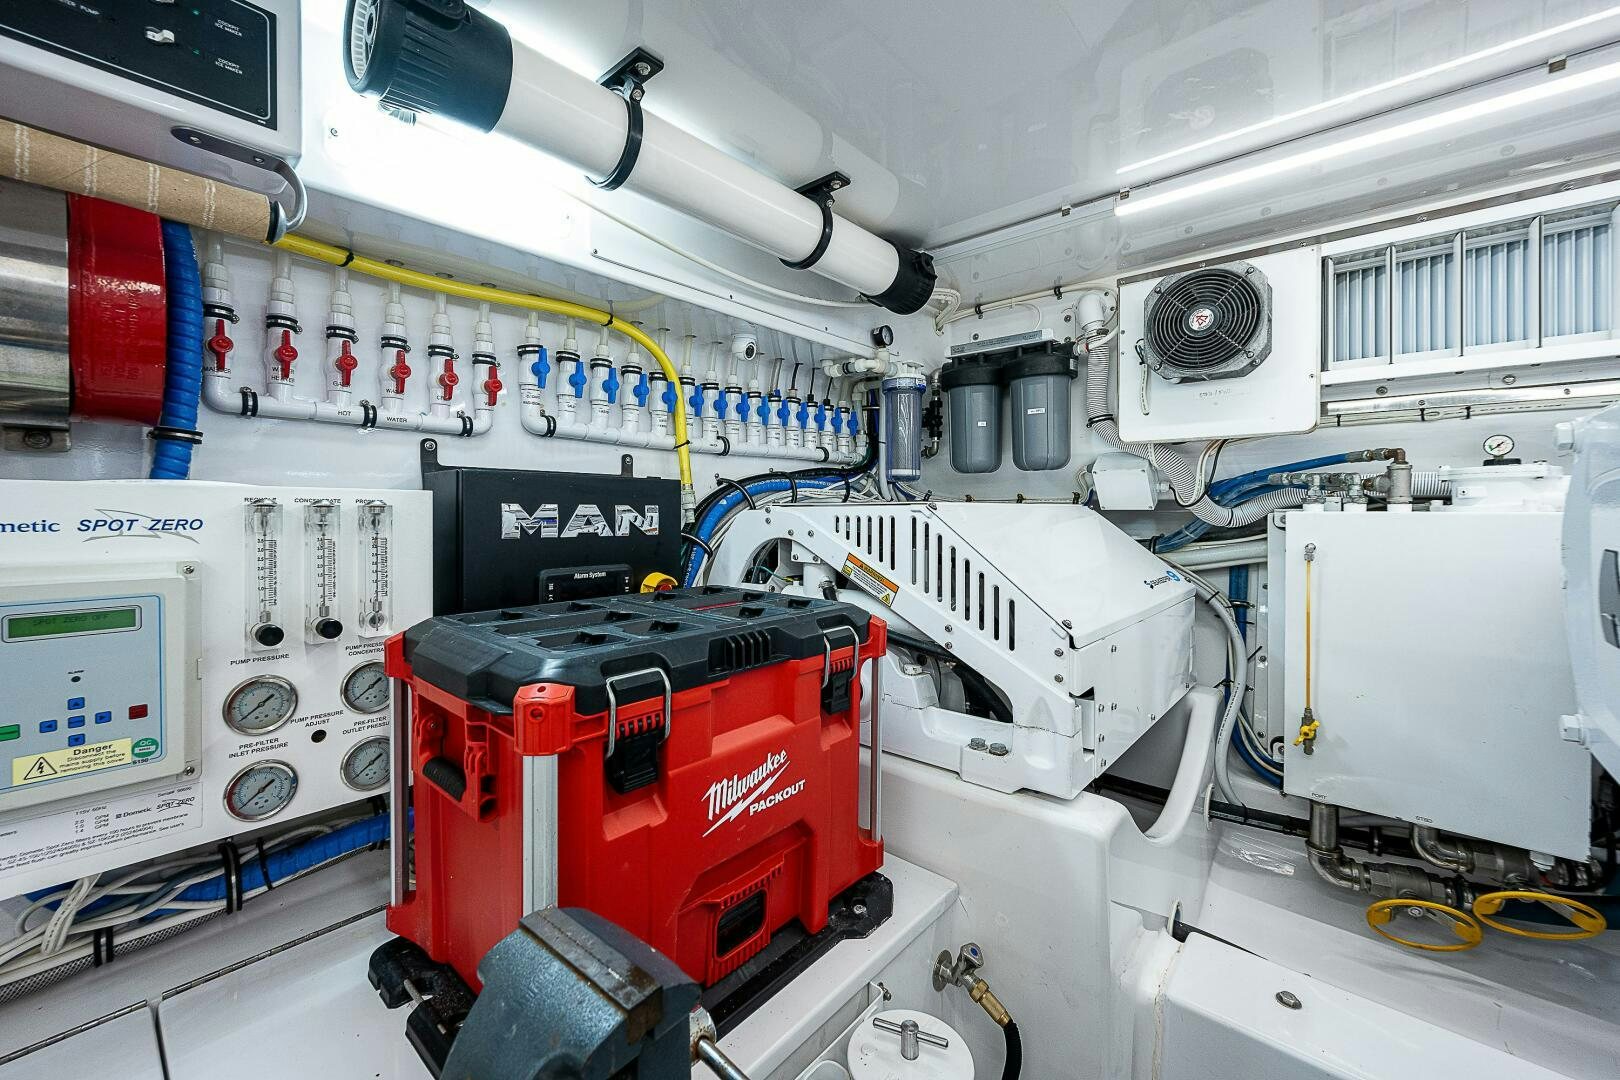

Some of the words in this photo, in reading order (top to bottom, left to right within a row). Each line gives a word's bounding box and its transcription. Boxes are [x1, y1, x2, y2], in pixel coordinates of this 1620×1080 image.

[218, 20, 239, 31] COCKPIT
[225, 26, 242, 36] MAKER
[218, 58, 240, 69] COCKPIT
[225, 65, 242, 74] MAKER
[77, 519, 139, 532] SPOT
[148, 518, 204, 531] ZERO
[501, 503, 659, 540] MAN
[348, 647, 385, 656] CONCENTRA
[253, 653, 289, 662] PRESSURE
[290, 716, 309, 724] PUMP
[310, 710, 344, 720] PRESSURE
[354, 716, 387, 726] PRE-FILTER
[305, 719, 330, 727] ADJUST
[343, 725, 365, 735] OUTLET
[367, 721, 390, 730] PRESSU
[74, 744, 113, 755] Danger
[239, 738, 279, 750] PRE-FILTER
[229, 750, 250, 758] INLET
[251, 742, 288, 754] PRESSURE
[67, 752, 104, 762] Disconnect
[82, 757, 103, 765] supply
[61, 765, 91, 773] removing
[701, 749, 788, 821] Milwaukee
[750, 779, 806, 816] PACKOUT
[123, 807, 151, 818] Dometic
